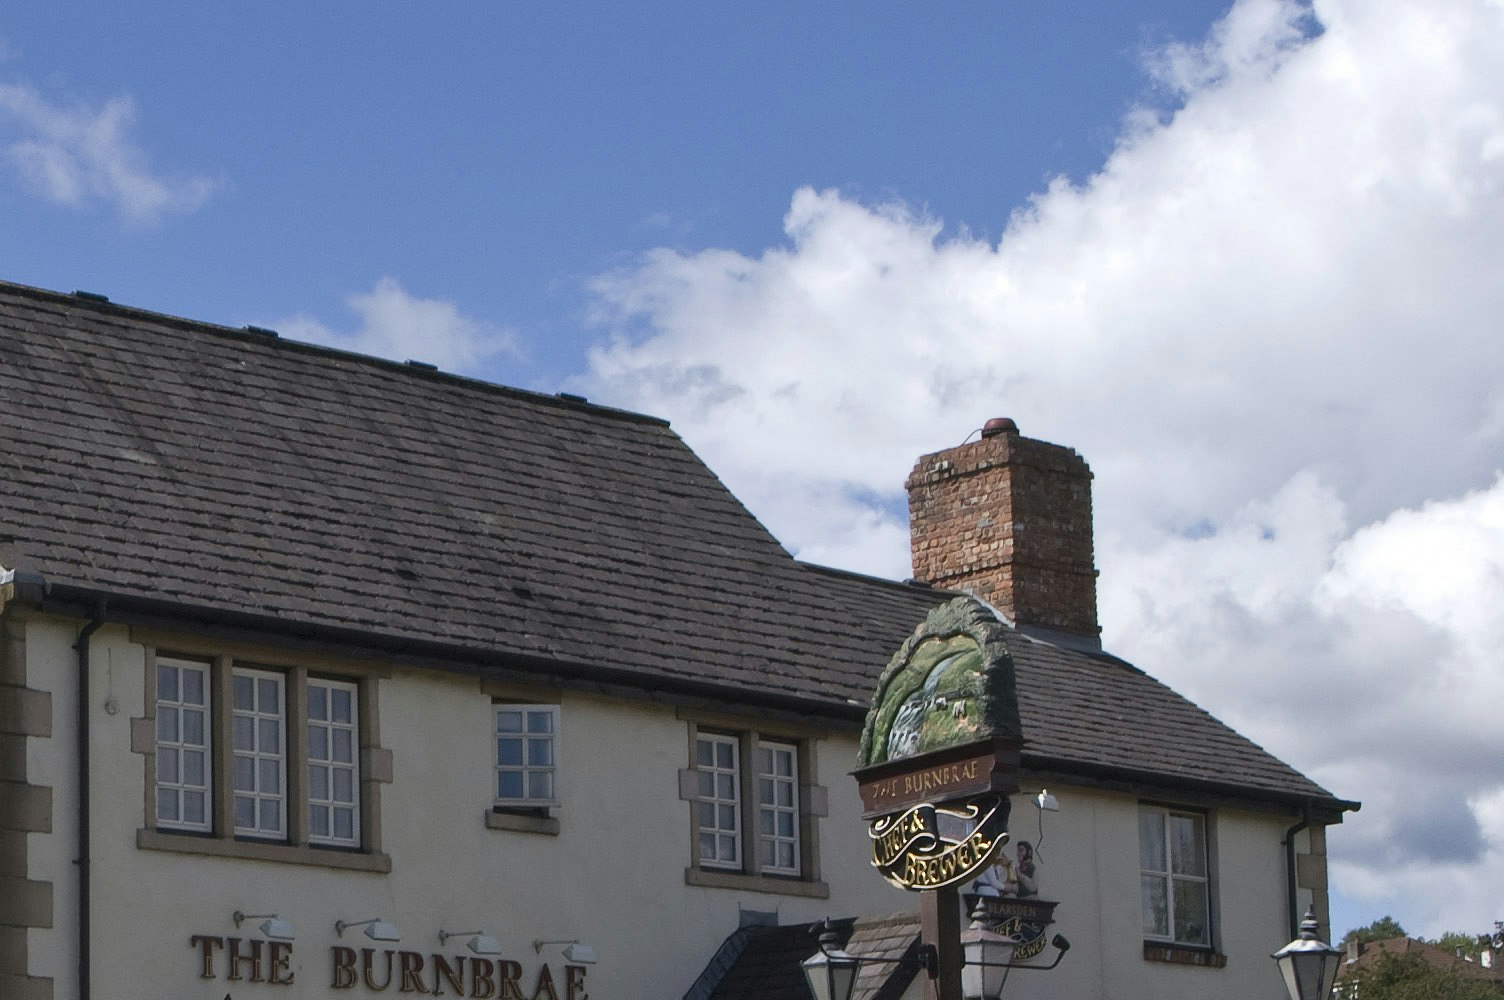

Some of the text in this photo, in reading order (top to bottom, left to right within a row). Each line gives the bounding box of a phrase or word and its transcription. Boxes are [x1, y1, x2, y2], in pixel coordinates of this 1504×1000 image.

[904, 761, 979, 794] BURNBRAE
[910, 809, 925, 833] &
[904, 832, 992, 885] BREWER
[191, 933, 296, 986] THE
[1013, 934, 1046, 960] REWER
